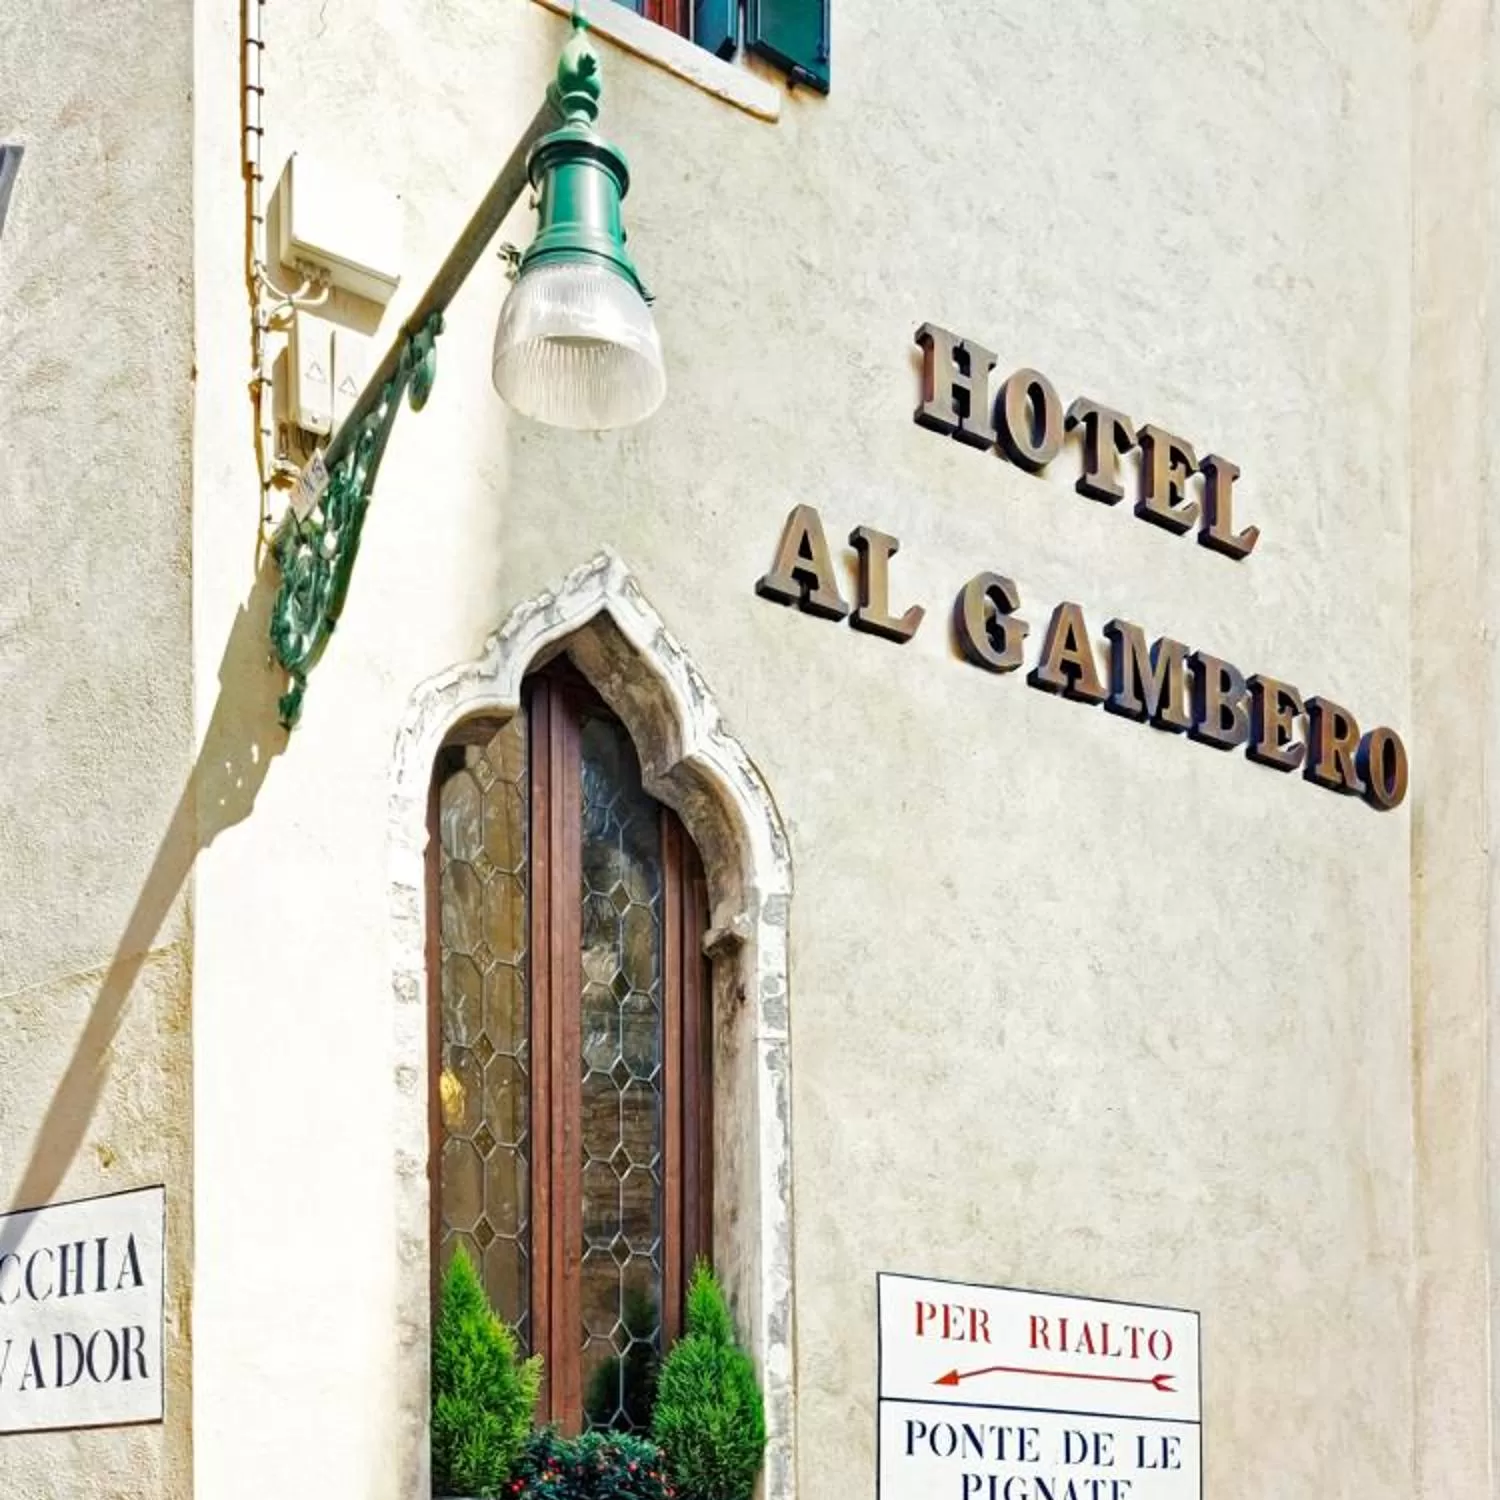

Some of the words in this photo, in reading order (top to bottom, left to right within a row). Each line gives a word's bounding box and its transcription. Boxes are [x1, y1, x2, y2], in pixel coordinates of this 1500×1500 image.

[913, 321, 1260, 561] HOTEL
[755, 503, 926, 645] AL
[952, 571, 1409, 812] GAMBERO
[0, 1231, 144, 1305] CCHIA
[914, 1300, 992, 1345] PER
[1029, 1314, 1174, 1361] RIALTO
[904, 1419, 1041, 1463] PONTE
[1062, 1430, 1115, 1468] DE
[1136, 1435, 1182, 1470] LE
